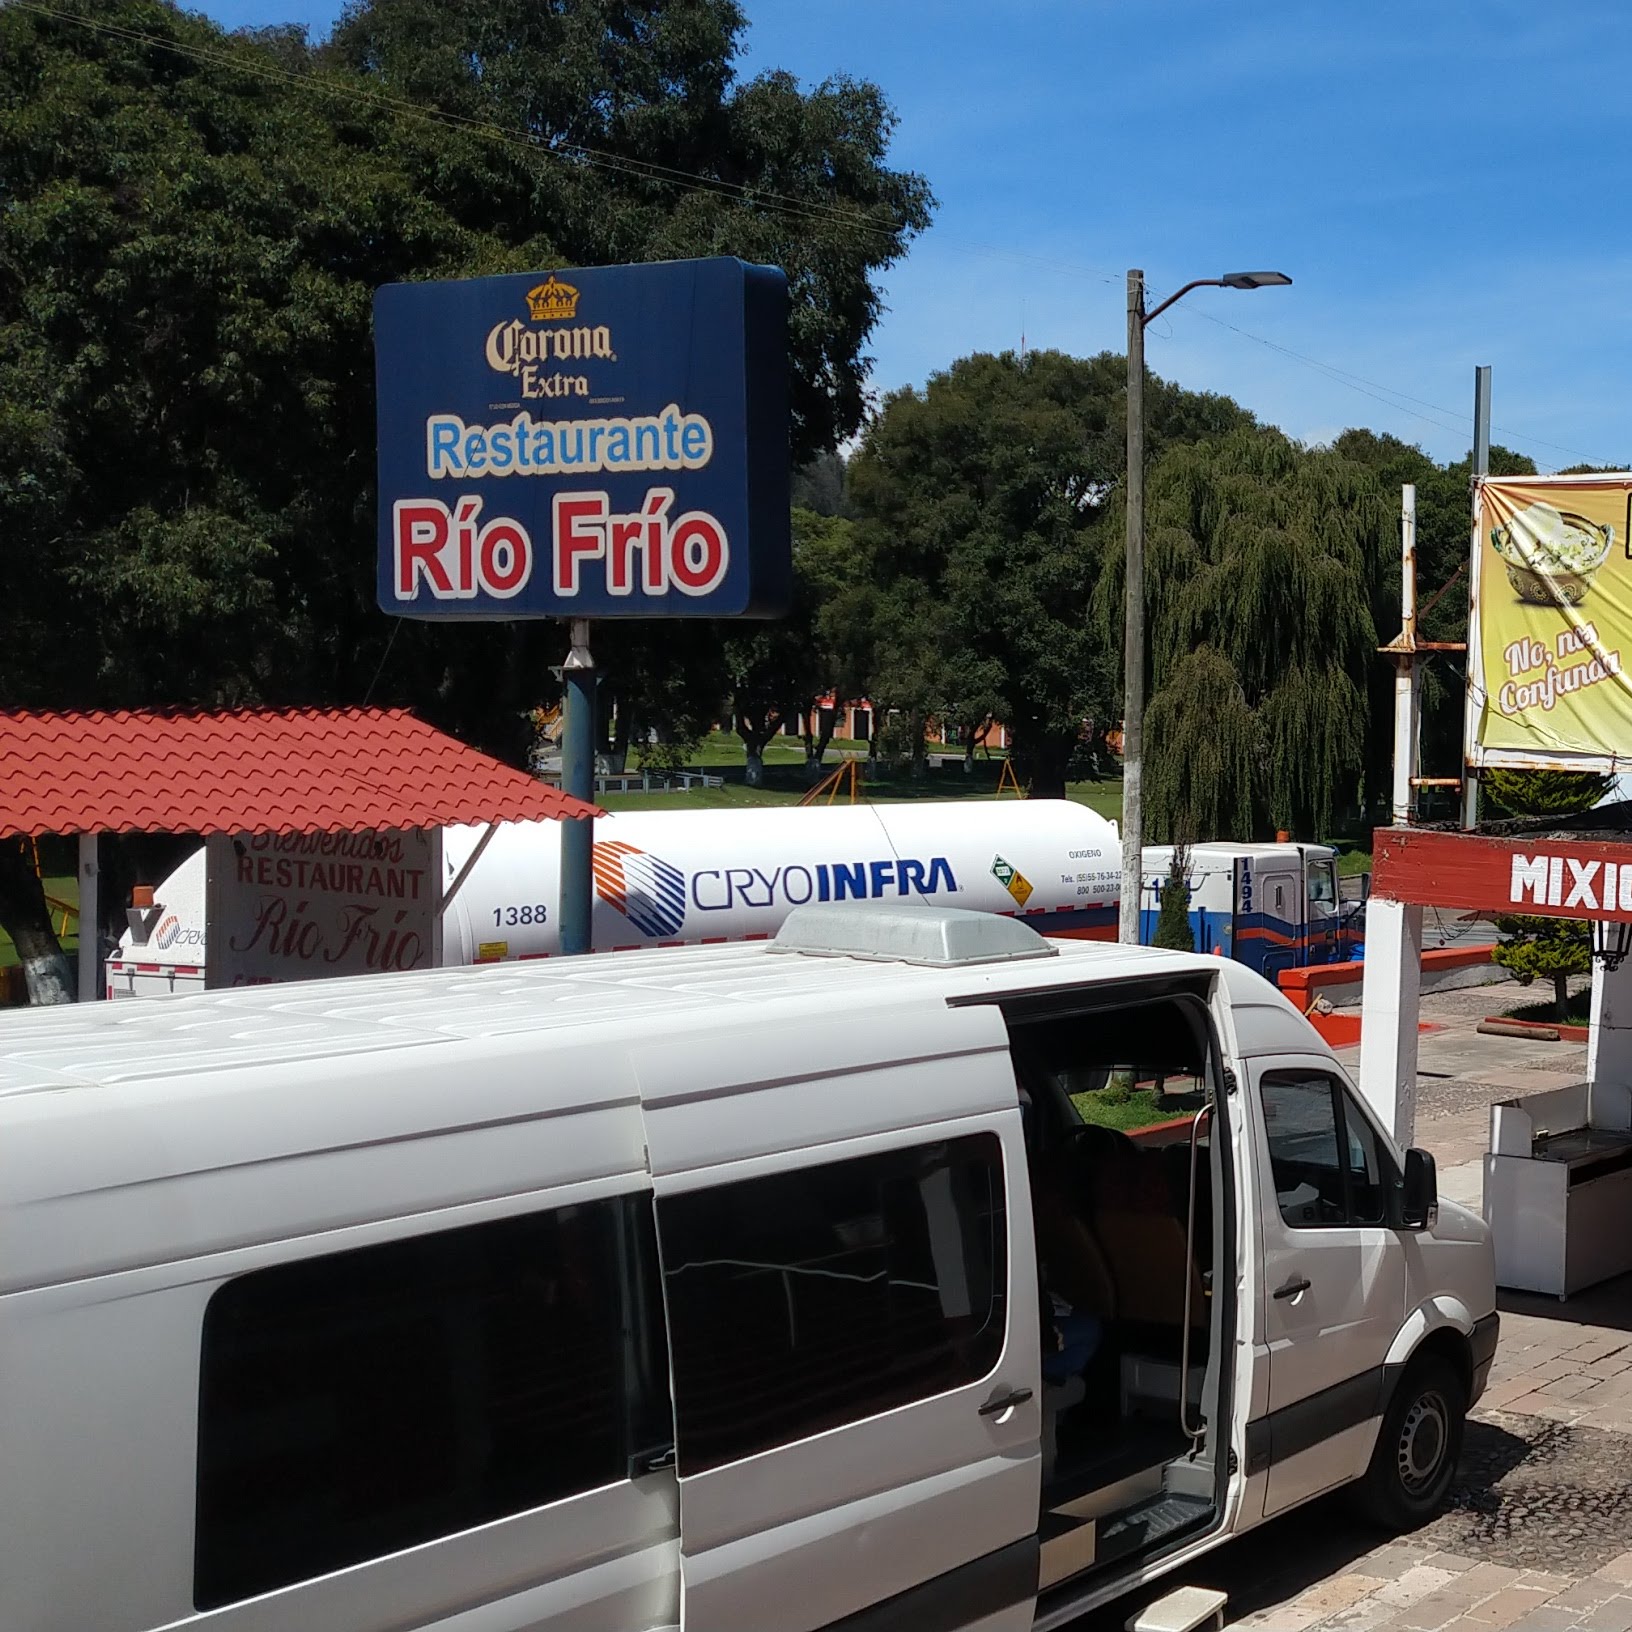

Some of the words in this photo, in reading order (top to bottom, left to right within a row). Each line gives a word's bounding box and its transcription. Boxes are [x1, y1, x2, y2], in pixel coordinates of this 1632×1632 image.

[485, 318, 614, 376] Corona
[520, 366, 589, 399] Extra
[430, 408, 710, 475] Restaurante
[397, 498, 530, 596] Río
[555, 491, 725, 592] Frío
[1498, 649, 1623, 715] Confunda
[1503, 636, 1554, 677] No,
[237, 856, 424, 899] RESTAURANT
[1069, 850, 1102, 859] OXIGENO
[691, 857, 959, 911] CRYOINFRA
[1077, 886, 1090, 895] 800
[1240, 857, 1253, 913] 1494
[229, 895, 323, 960] Río
[324, 904, 424, 971] Frío
[493, 905, 547, 927] 1388
